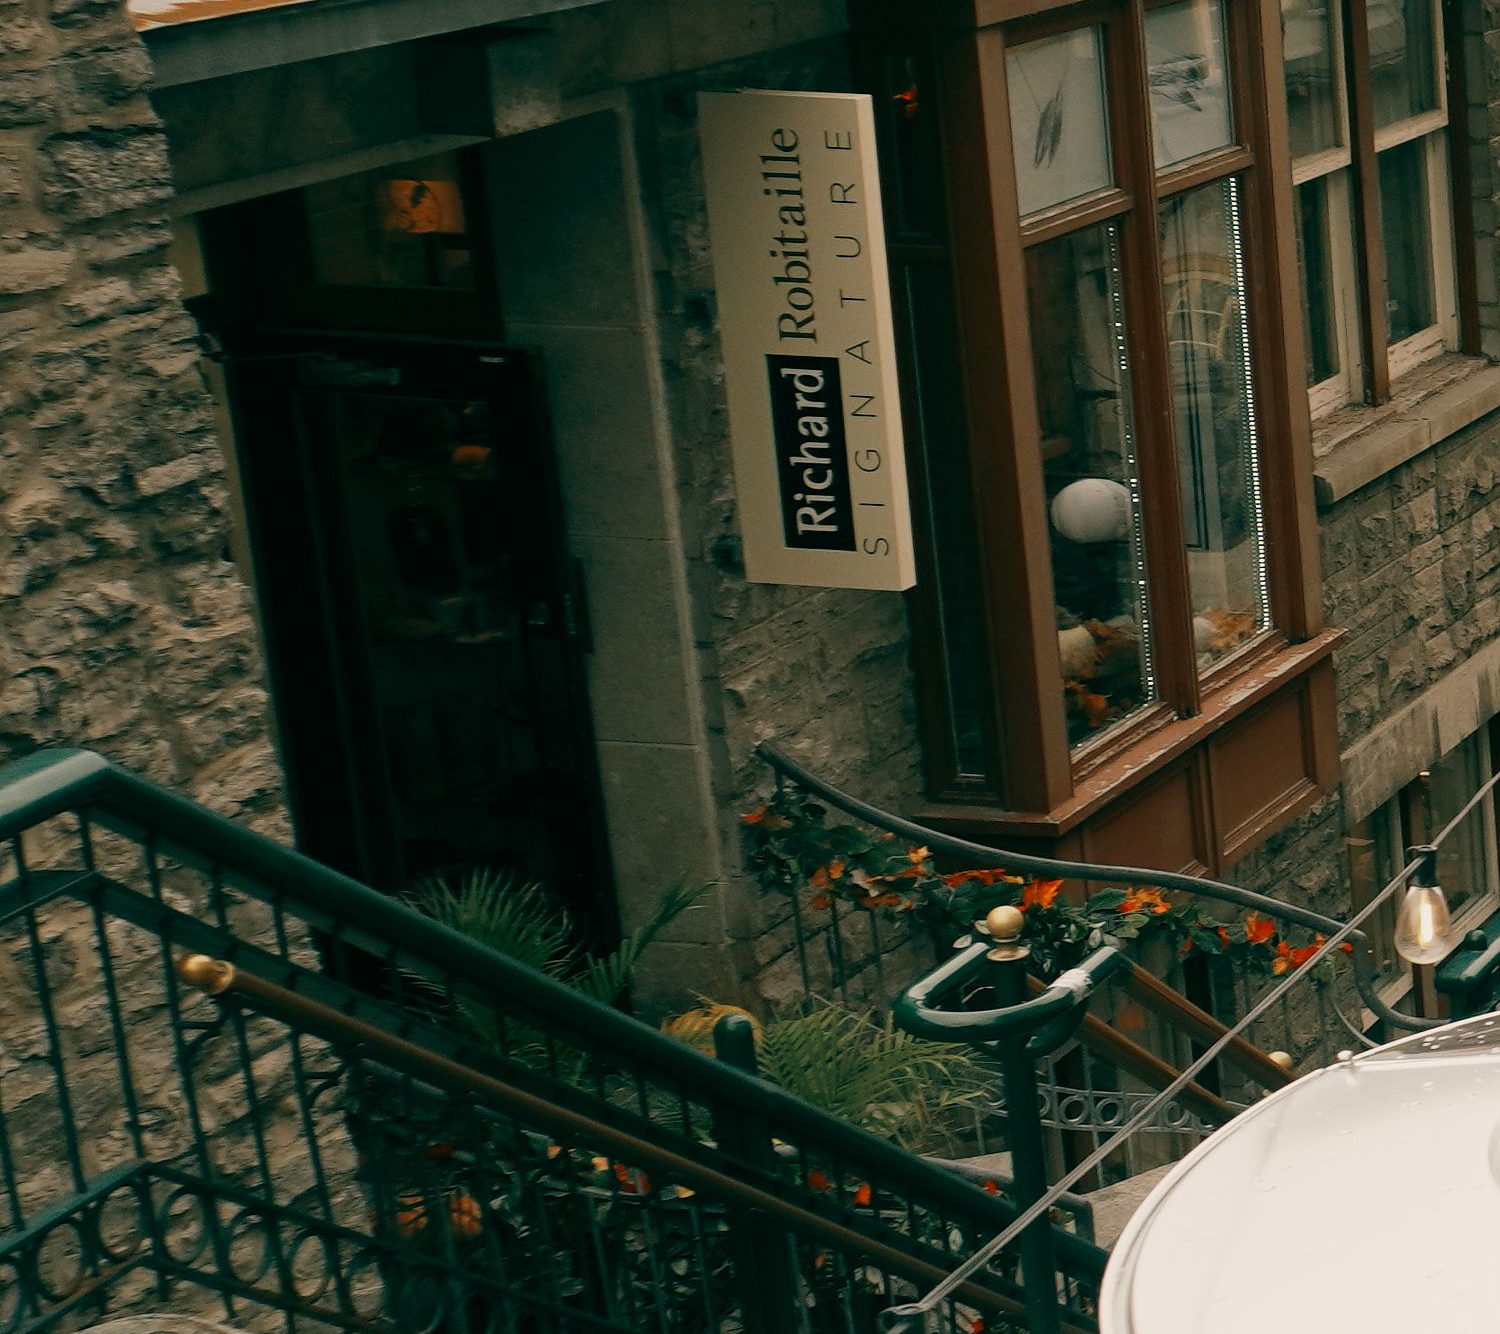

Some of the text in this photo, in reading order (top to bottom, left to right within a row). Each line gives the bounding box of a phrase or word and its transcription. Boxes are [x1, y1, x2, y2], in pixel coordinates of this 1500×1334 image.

[761, 128, 840, 536] Richard Robitaille
[825, 127, 890, 557] SIGNATURE
